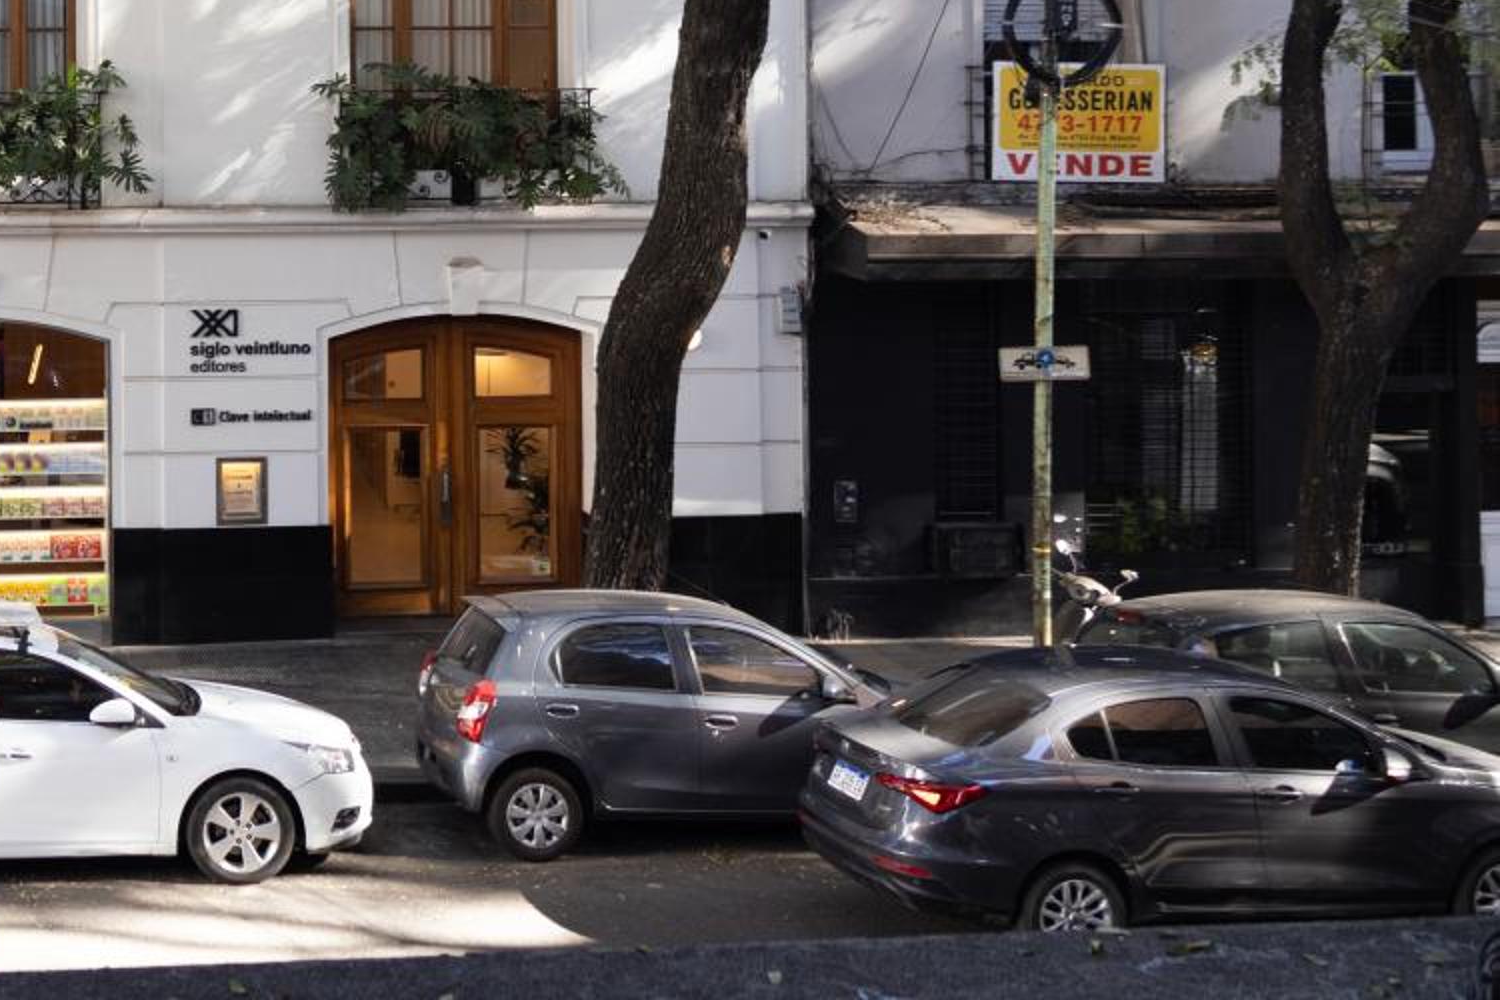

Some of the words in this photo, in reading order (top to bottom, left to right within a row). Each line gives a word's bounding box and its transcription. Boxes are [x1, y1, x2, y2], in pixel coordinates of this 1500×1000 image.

[1018, 114, 1143, 133] 473-1717
[190, 341, 231, 358] siglo
[235, 341, 311, 355] veintiuno
[190, 360, 246, 373] editores
[219, 411, 249, 422] Clave
